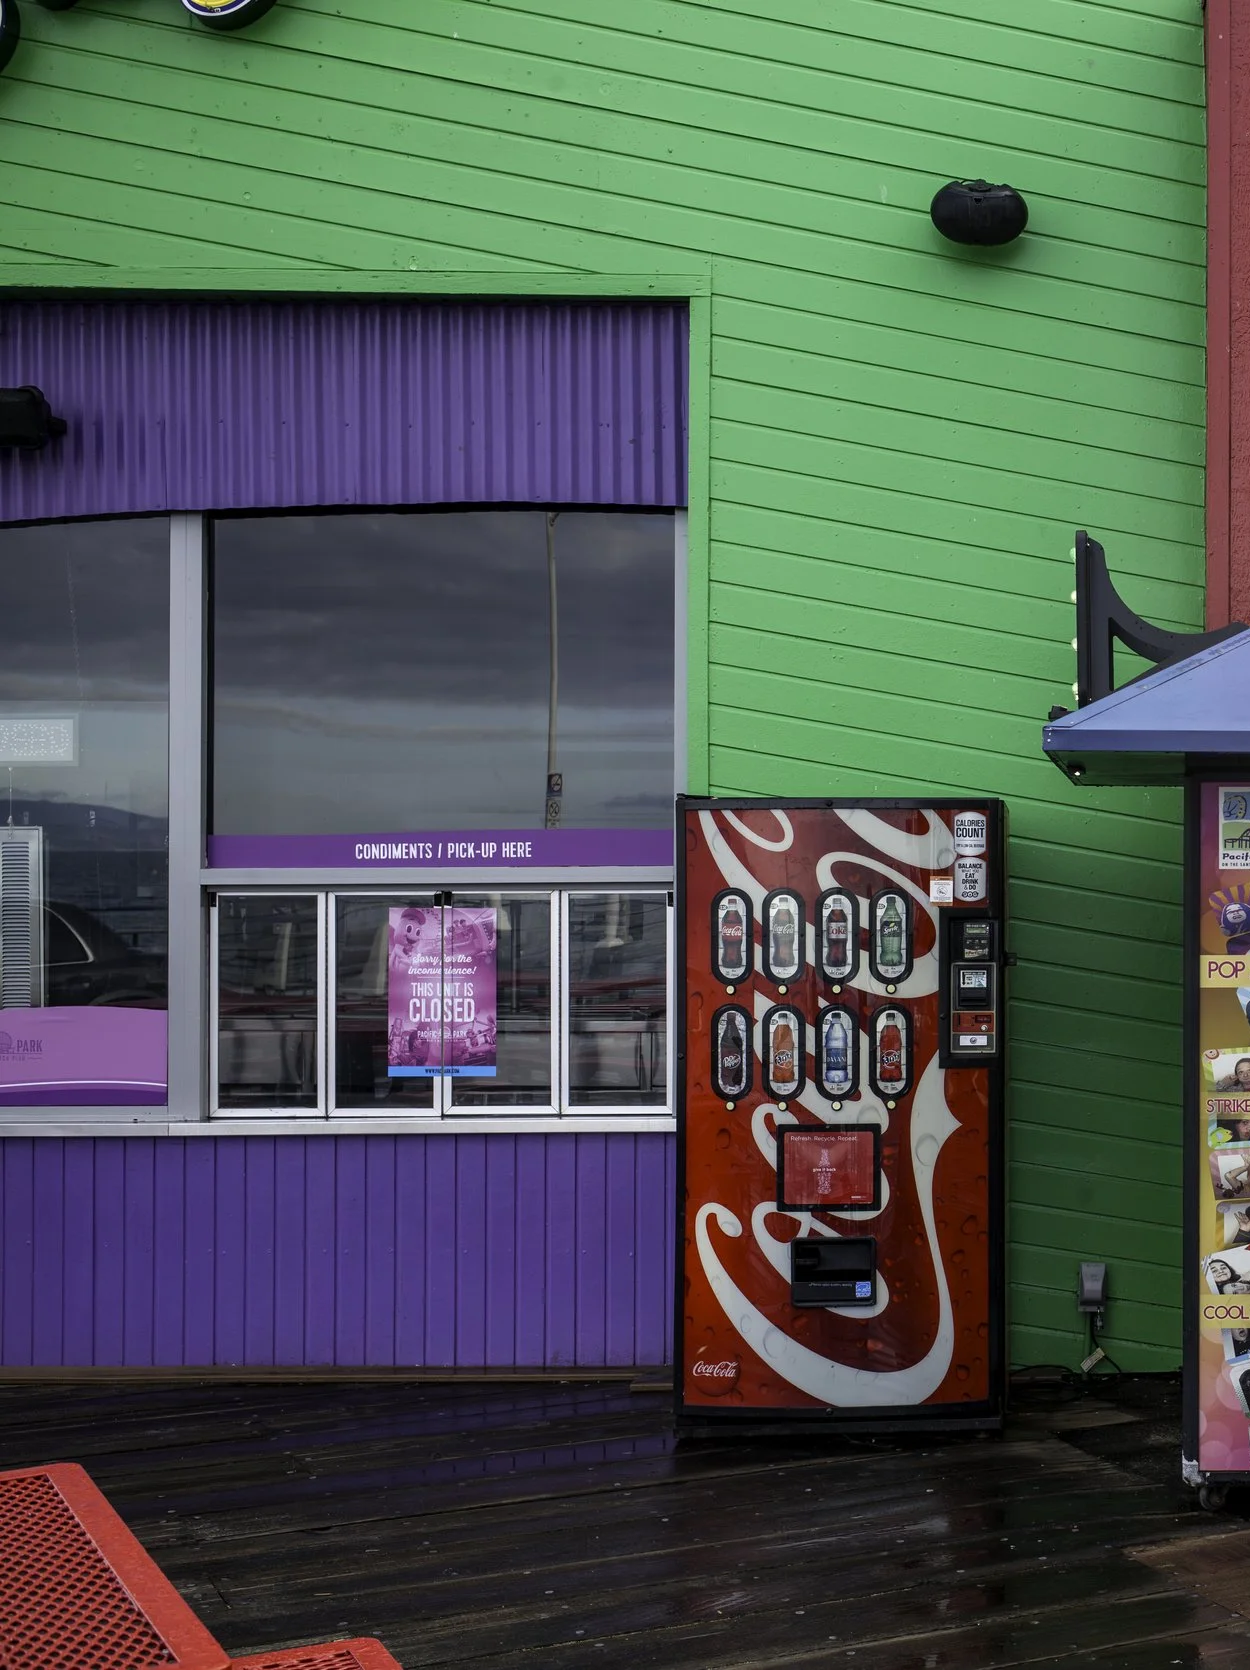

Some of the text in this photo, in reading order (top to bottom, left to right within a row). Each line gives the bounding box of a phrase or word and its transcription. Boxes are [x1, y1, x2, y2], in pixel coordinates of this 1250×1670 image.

[956, 819, 985, 827] CALORIES
[956, 828, 985, 838] COUNT
[355, 843, 433, 859] CONDIMENTS
[447, 842, 497, 858] PICK-UP
[502, 841, 532, 858] HERE
[413, 953, 440, 965] Sorry
[457, 954, 473, 963] the
[1208, 961, 1245, 979] POP
[411, 982, 474, 997] THIS UNIT IS
[409, 998, 475, 1023] CLOSED
[17, 1039, 43, 1052] PARK
[1203, 1305, 1249, 1320] COOL
[692, 1361, 739, 1377] Coca-Cola
